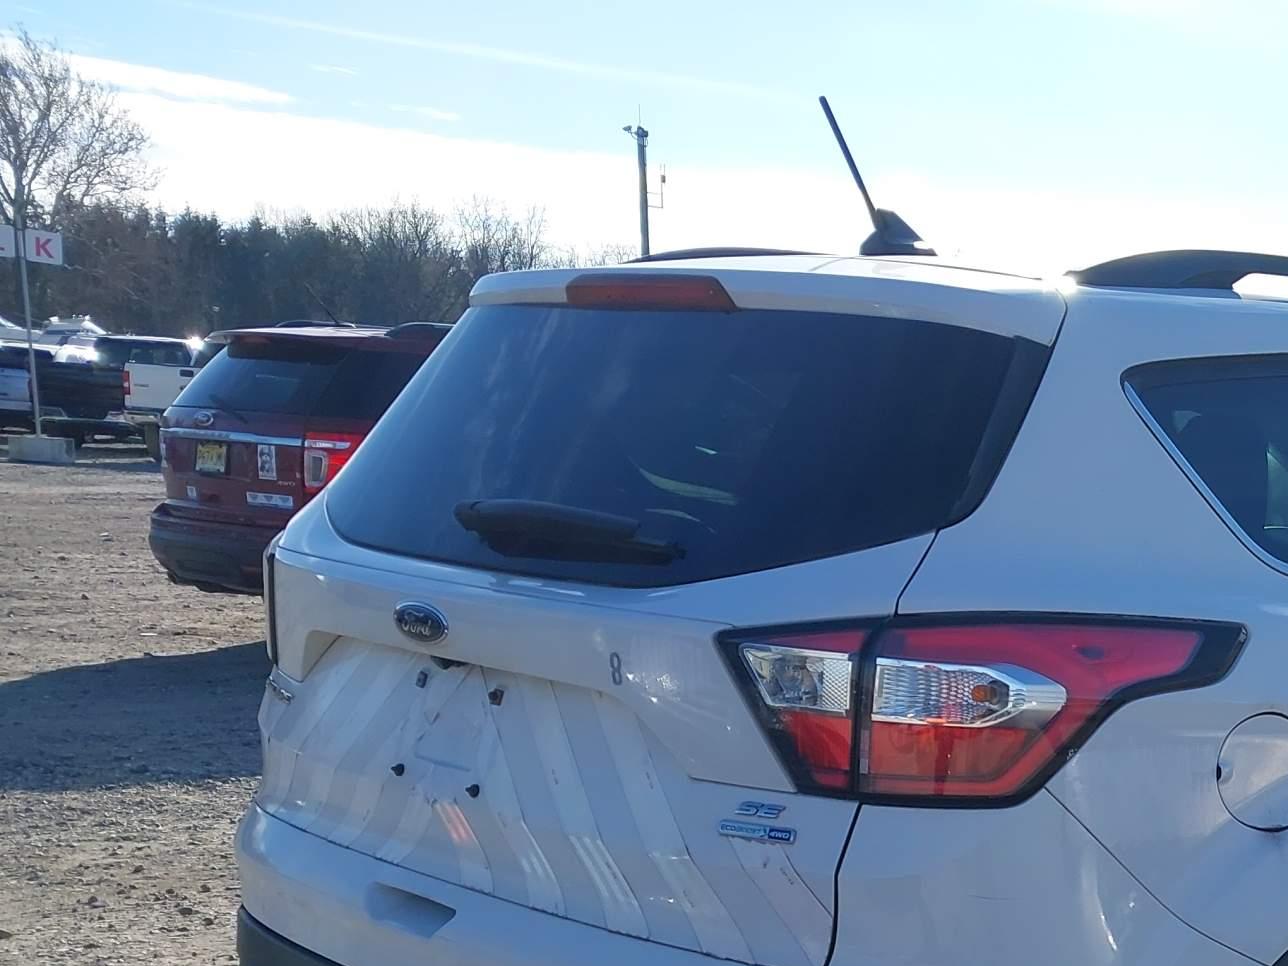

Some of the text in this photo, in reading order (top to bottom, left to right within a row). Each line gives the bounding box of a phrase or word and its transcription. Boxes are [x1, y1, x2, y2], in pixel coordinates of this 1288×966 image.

[35, 236, 54, 259] K
[401, 609, 431, 636] Ford
[609, 652, 622, 686] 8
[734, 801, 786, 819] SE
[768, 830, 790, 840] 4WD
